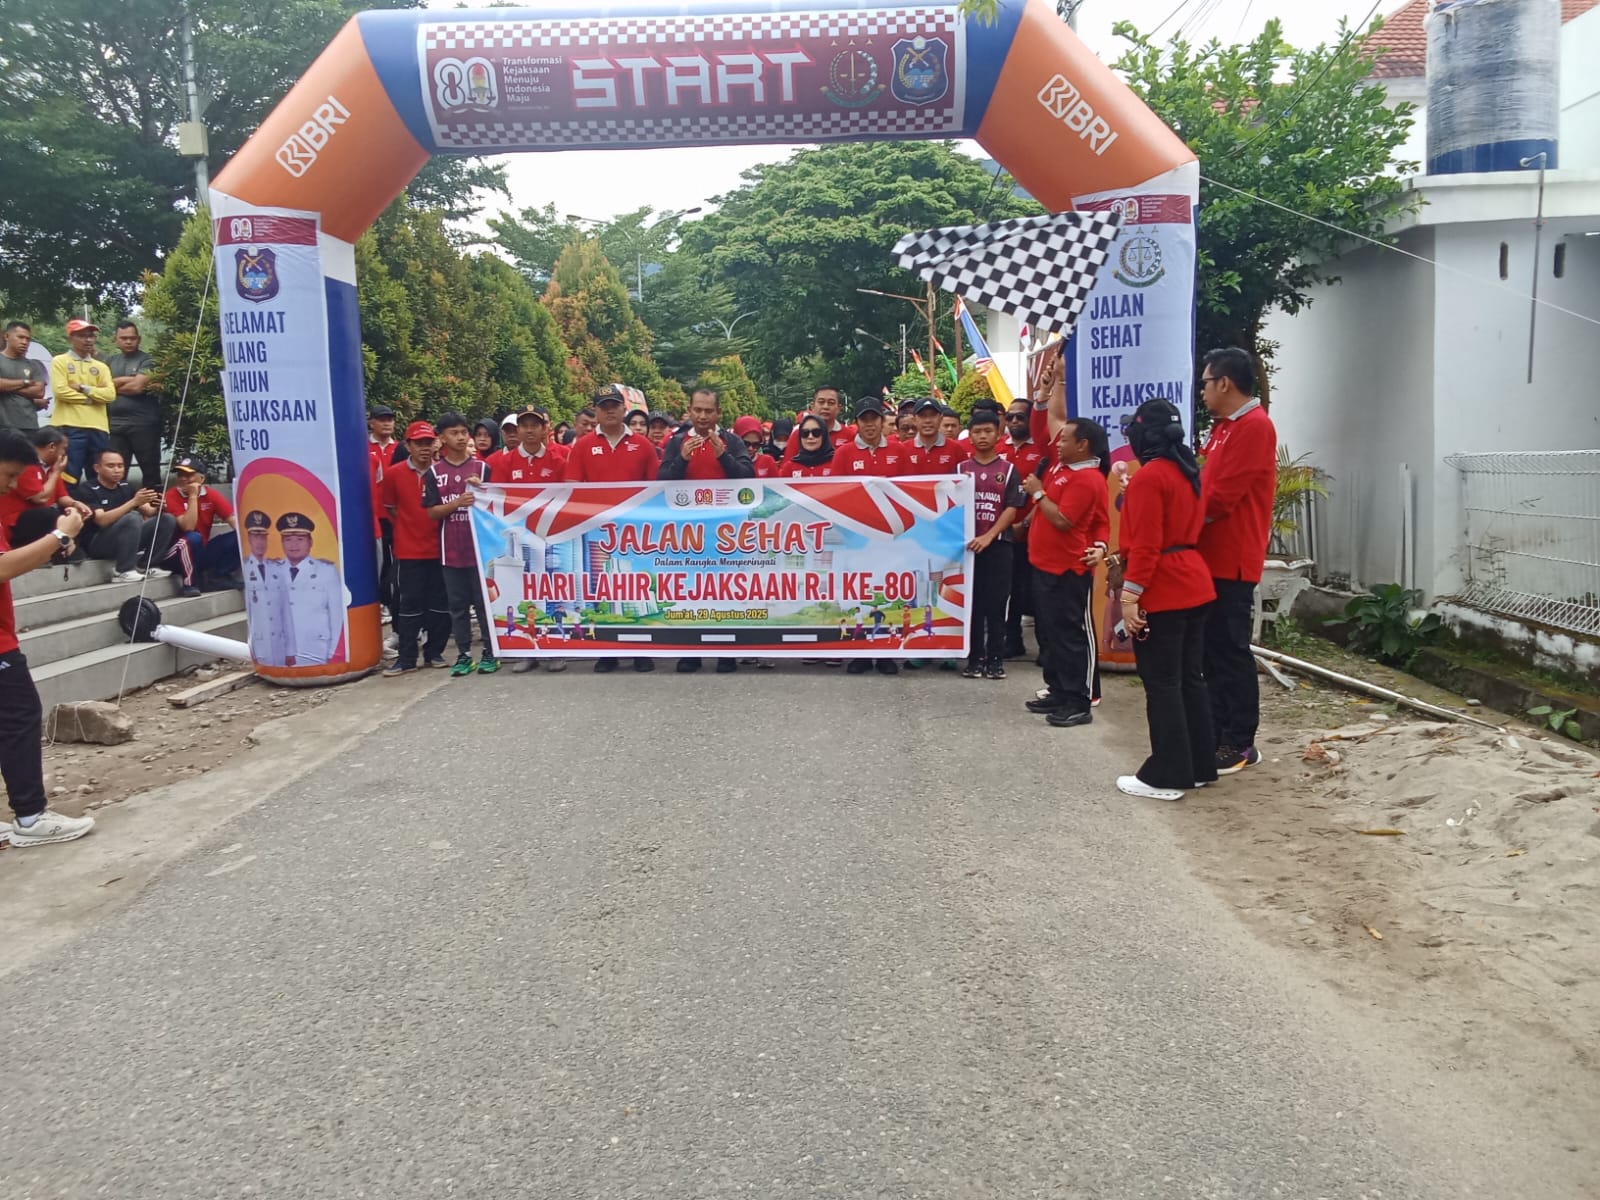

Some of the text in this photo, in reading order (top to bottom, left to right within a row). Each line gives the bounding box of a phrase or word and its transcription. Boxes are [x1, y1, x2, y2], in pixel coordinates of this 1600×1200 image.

[502, 56, 563, 65] Transformasi
[502, 66, 551, 76] Kejaksaan
[504, 75, 540, 85] Menuju
[505, 84, 551, 93] Indonesia
[571, 50, 813, 108] START
[506, 94, 531, 104] Maju
[298, 95, 352, 152] BRI
[1063, 99, 1119, 156] BRI
[1090, 293, 1144, 320] JALAN
[225, 311, 286, 334] SELAMAT
[1091, 324, 1142, 350] SEHAT
[226, 340, 268, 363] ULANG
[1091, 355, 1122, 380] HUT
[228, 370, 270, 393] TAHUN
[232, 399, 317, 422] KEJAKSAAN
[234, 428, 270, 451] KE-80
[436, 473, 449, 488] 37
[599, 521, 832, 554] JALAN SEHAT
[654, 557, 776, 568] Dalam Rangka Memperingati
[522, 572, 915, 601] HARI LAHIR KEJAKSAAN R.I KE-80
[697, 609, 709, 620] 29
[710, 609, 745, 622] Agustus
[746, 609, 768, 620] 2025
